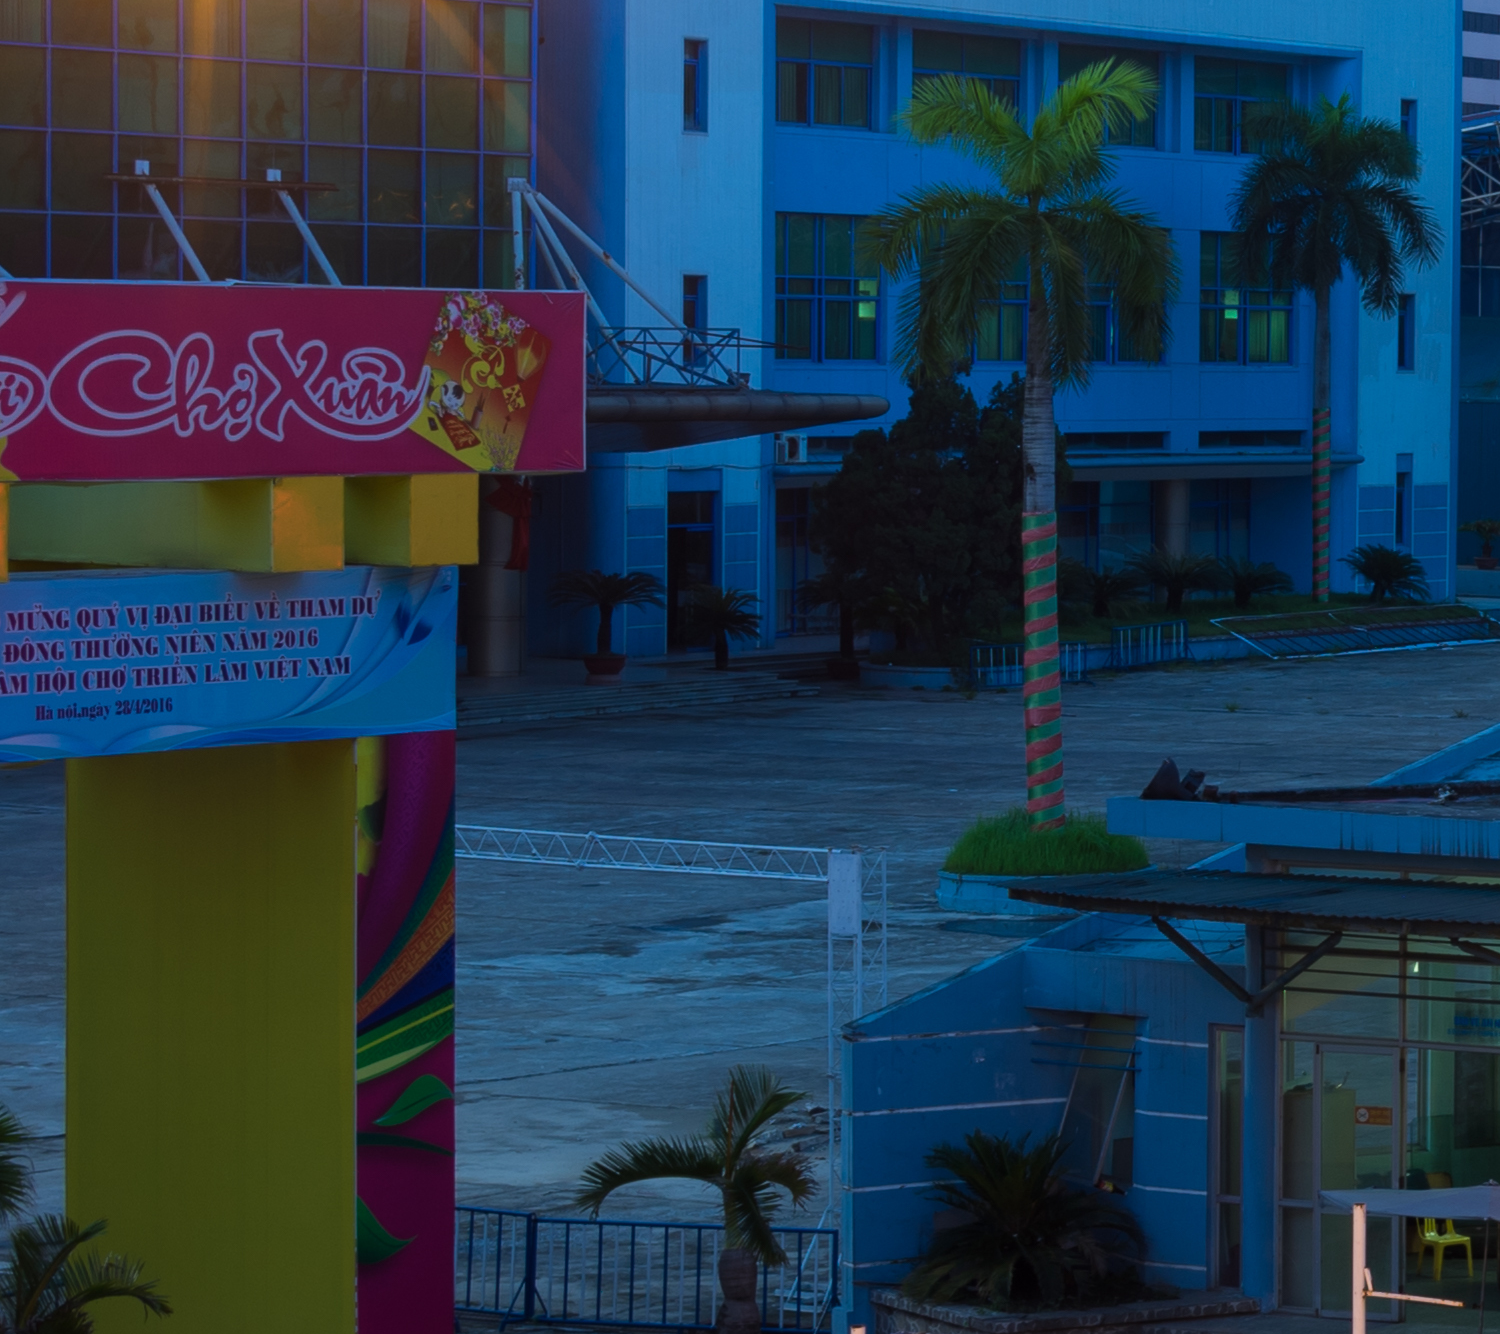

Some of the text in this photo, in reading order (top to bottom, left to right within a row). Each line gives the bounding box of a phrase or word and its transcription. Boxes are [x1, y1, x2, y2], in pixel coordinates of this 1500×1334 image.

[49, 329, 258, 441] Chợ
[249, 329, 430, 441] Xuân
[76, 601, 120, 634] QUÝ
[125, 605, 149, 630] VỊ
[153, 604, 192, 629] ĐẠI
[199, 592, 248, 622] BIỂU
[255, 590, 281, 620] VỀ
[287, 596, 345, 620] THAM
[351, 589, 381, 620] DỰ
[3, 627, 319, 664] ĐÔNG THƯỜNG NIÊN NĂM 2016
[34, 666, 77, 696] HỘI
[82, 664, 127, 694] CHỢ
[132, 656, 198, 687] TRIỂN
[253, 654, 301, 683] VIỆT
[307, 656, 351, 677] NAM
[35, 702, 53, 721] Hà
[115, 697, 173, 716] 28/4/2016
